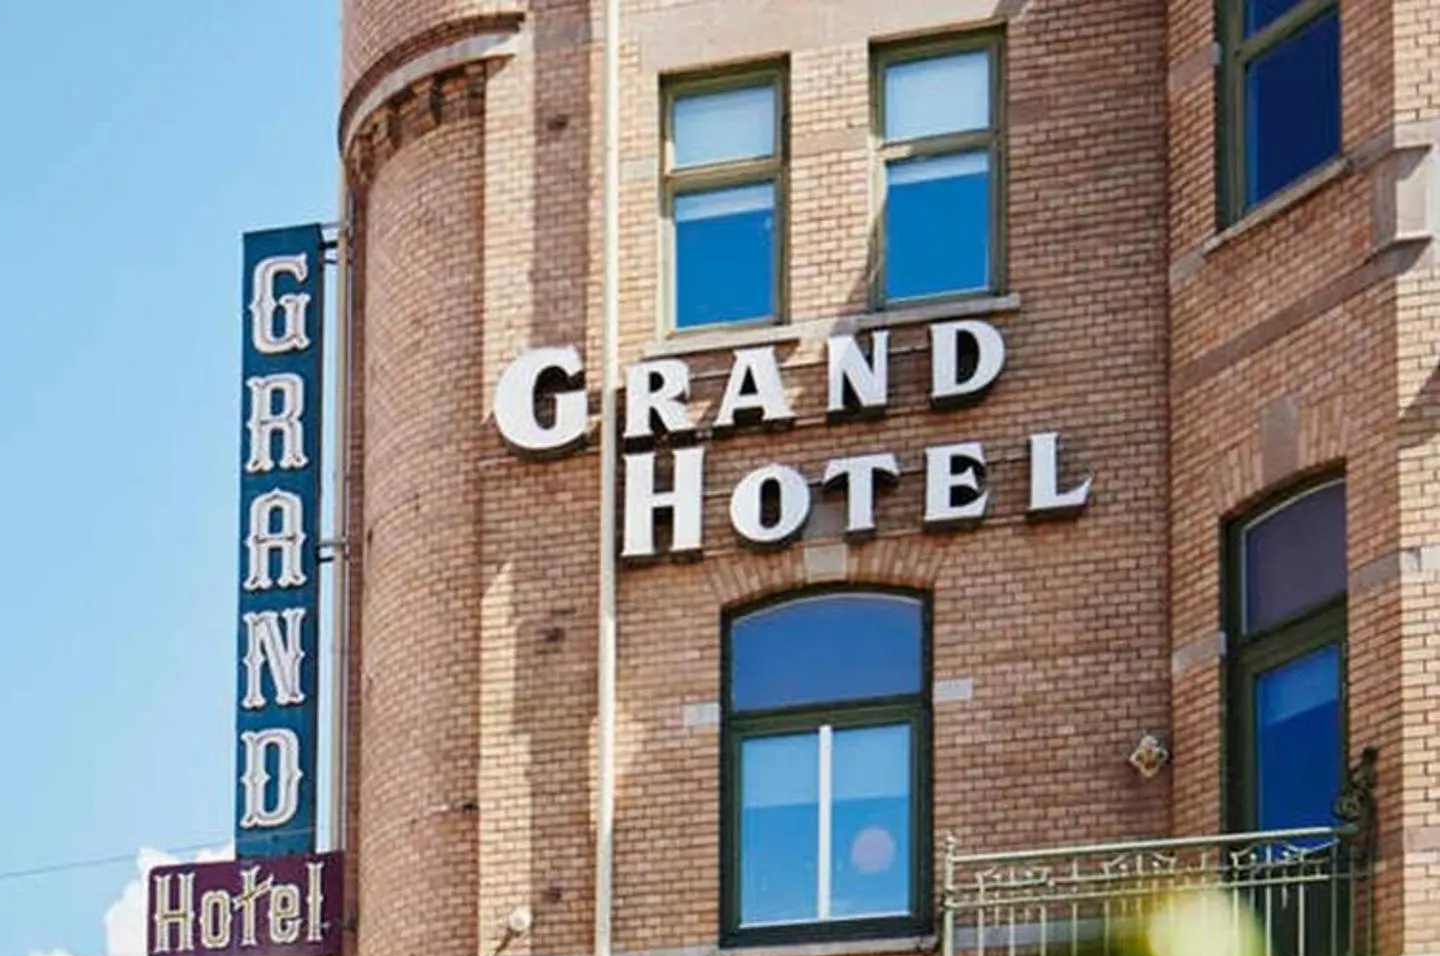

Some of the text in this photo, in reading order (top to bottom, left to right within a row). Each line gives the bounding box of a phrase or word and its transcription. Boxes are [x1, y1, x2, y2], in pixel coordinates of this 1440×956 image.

[491, 319, 1007, 453] GRAND
[239, 251, 312, 830] GRAND
[620, 431, 1094, 557] HOTEL
[153, 862, 326, 953] Hotel
